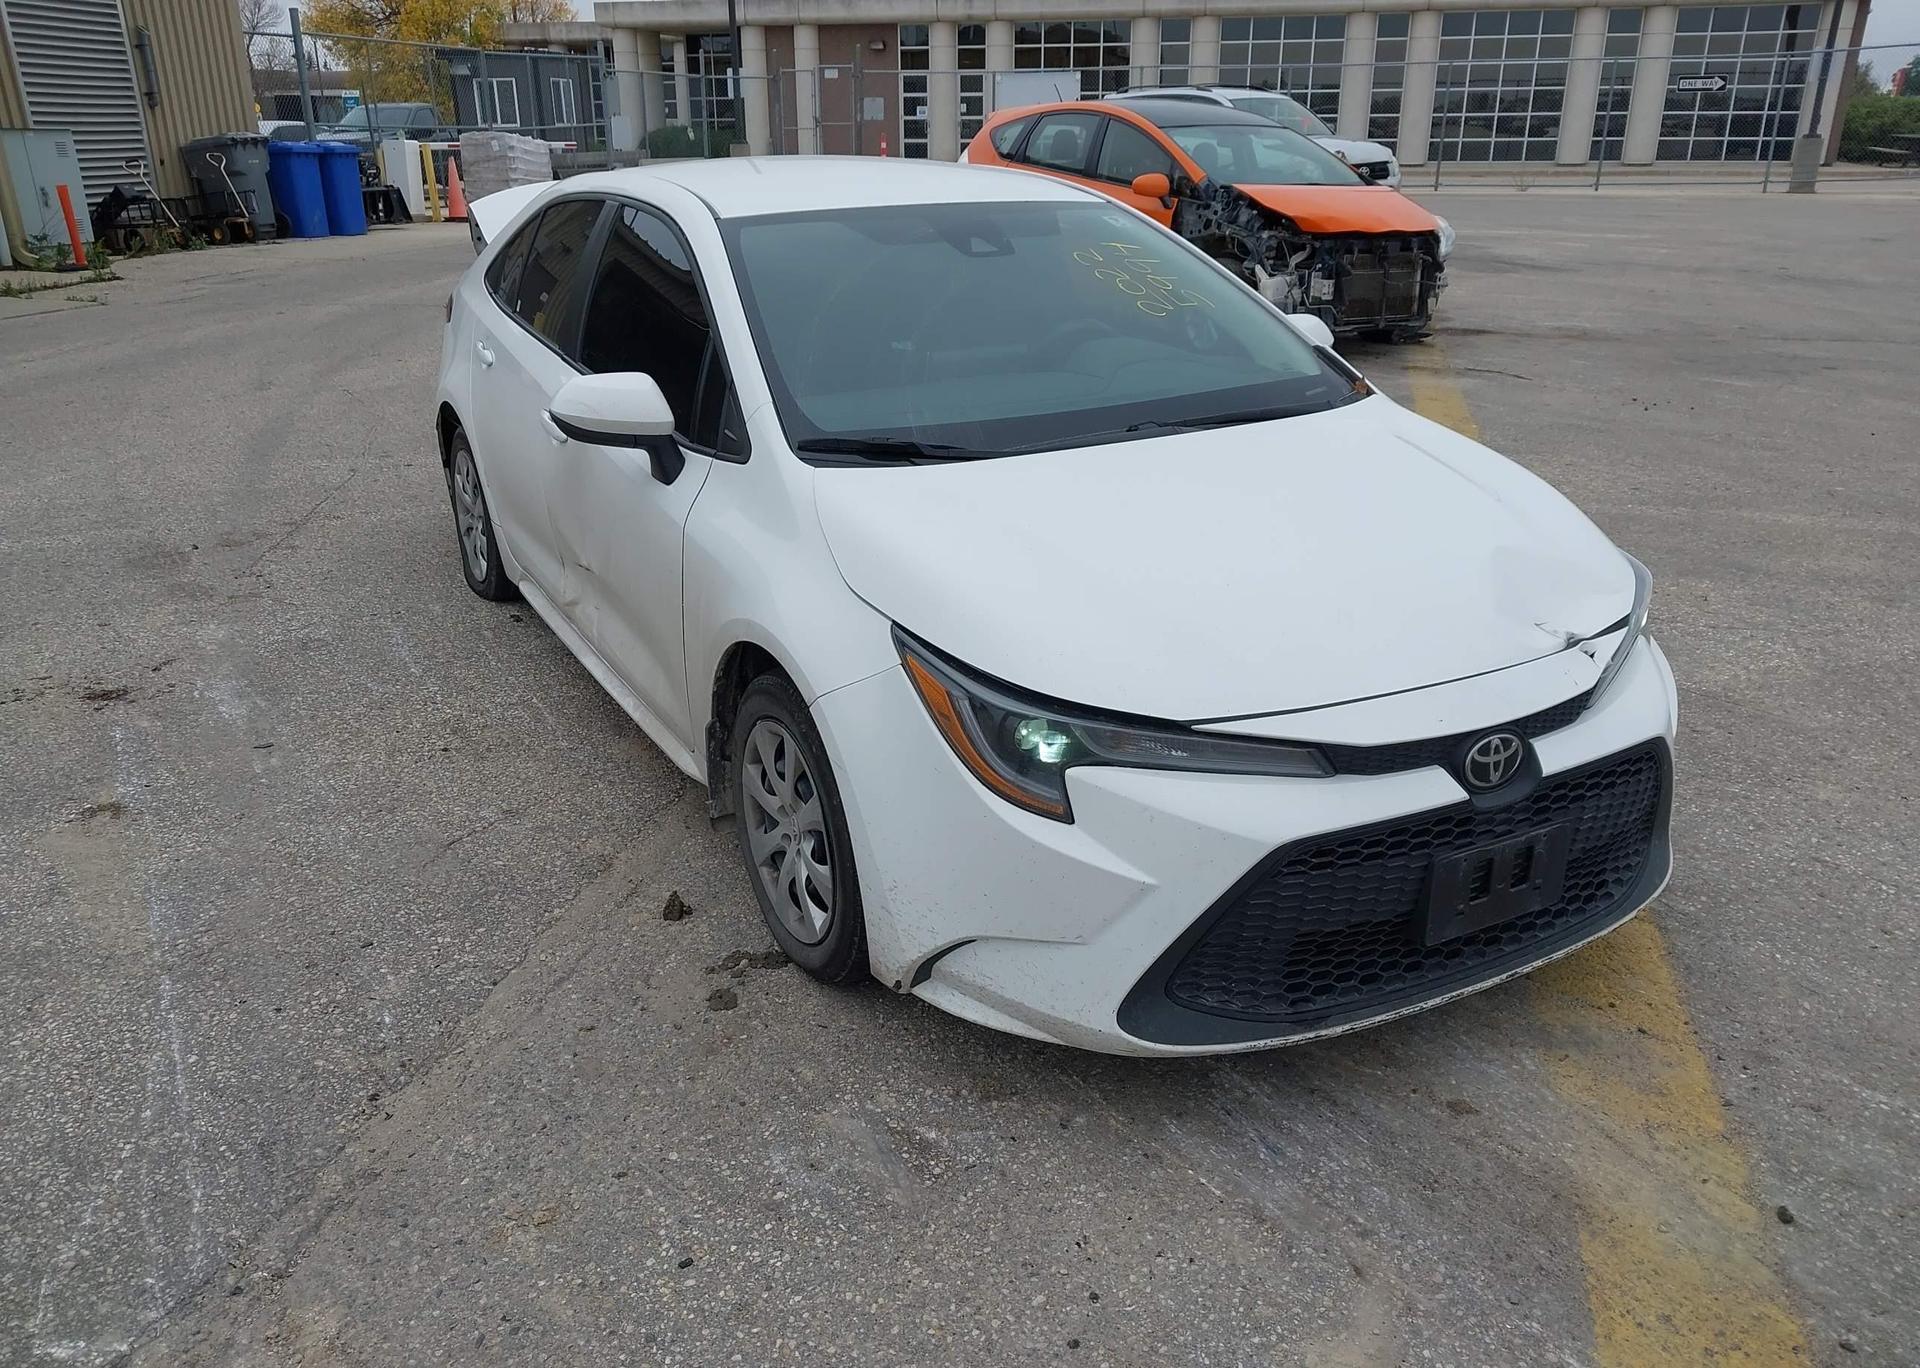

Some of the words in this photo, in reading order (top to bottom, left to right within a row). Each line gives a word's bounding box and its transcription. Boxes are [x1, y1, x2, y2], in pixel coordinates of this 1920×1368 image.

[1681, 80, 1698, 88] ONE
[1701, 79, 1719, 87] WAY
[1072, 248, 1174, 316] 2022
